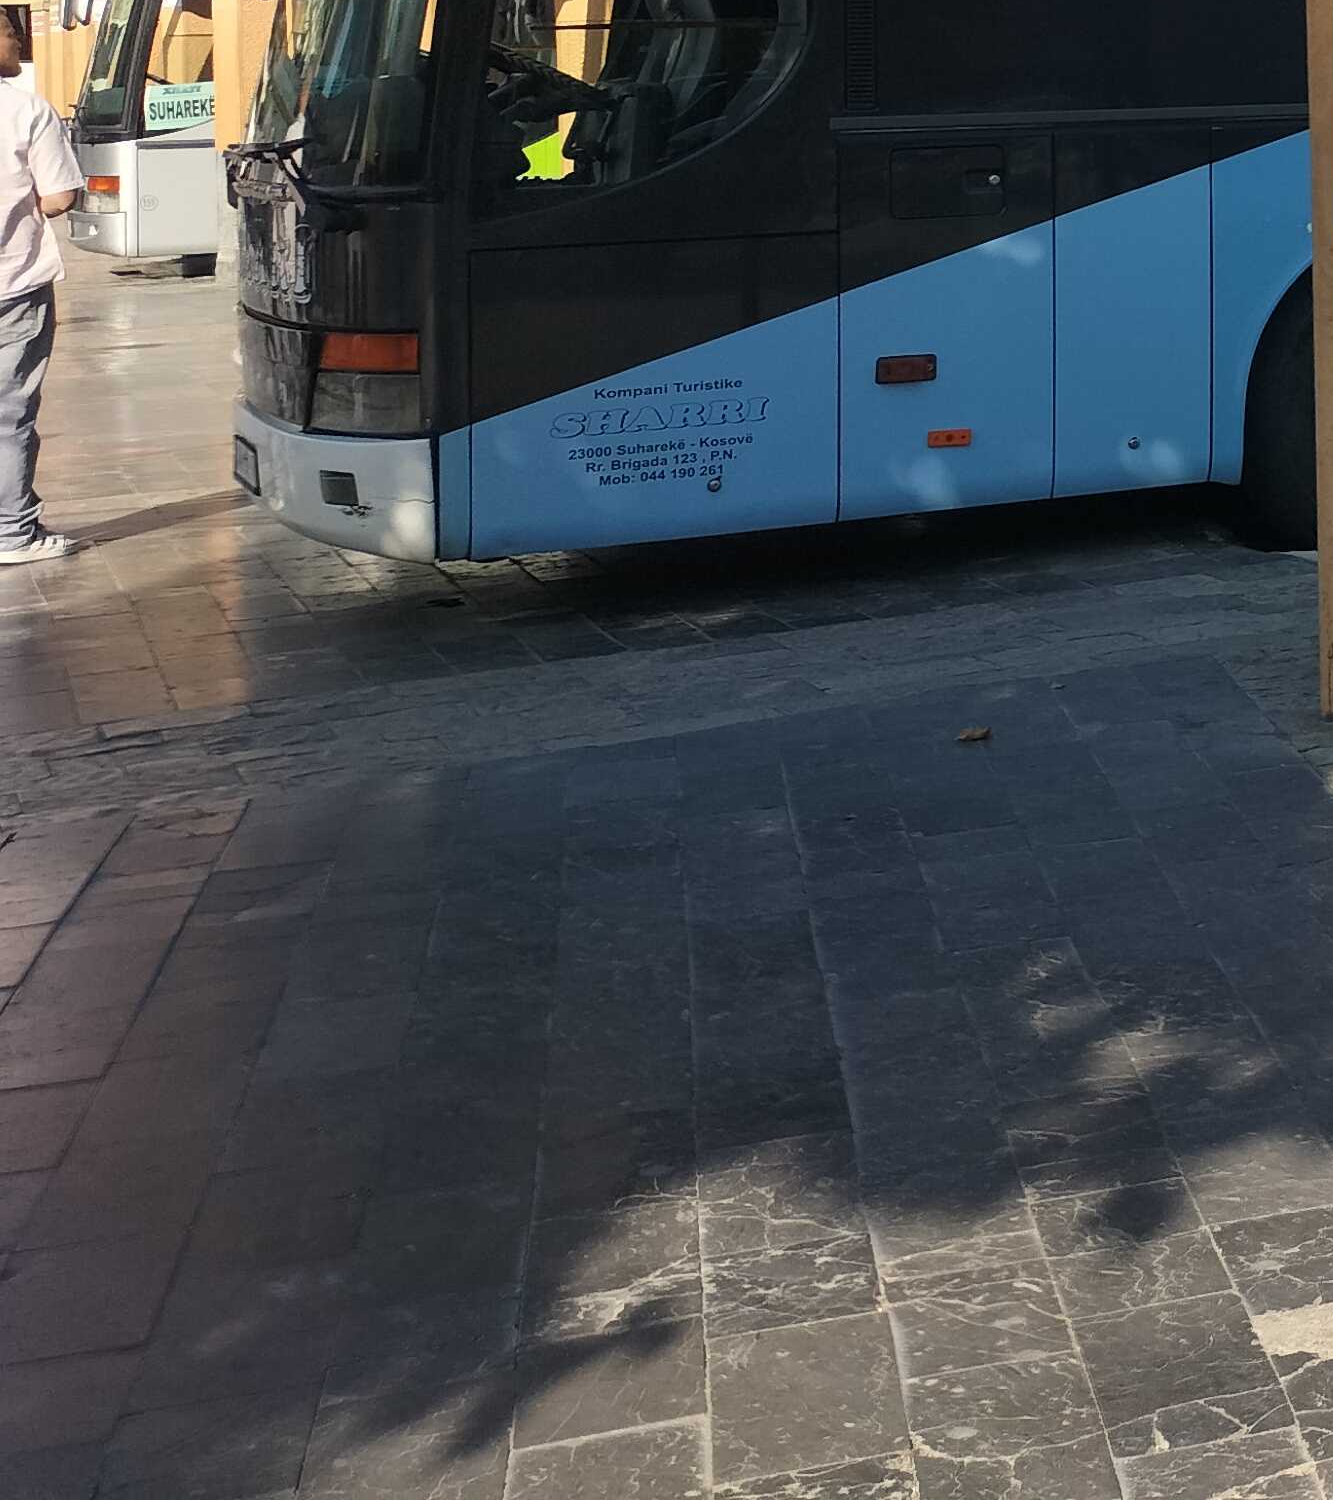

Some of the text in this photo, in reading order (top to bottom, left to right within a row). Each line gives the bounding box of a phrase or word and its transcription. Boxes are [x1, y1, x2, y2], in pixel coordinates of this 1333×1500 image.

[593, 379, 743, 399] Kompani Turistike
[550, 396, 770, 438] SHARRI
[568, 446, 612, 460] 23000
[616, 439, 686, 455] Suharekë
[699, 433, 753, 448] Kosovë
[585, 462, 606, 473] Rr.
[611, 455, 668, 471] Brigada
[673, 453, 698, 465] 123
[710, 449, 737, 461] P.N.
[599, 464, 723, 486] Mob: 044 190 261
